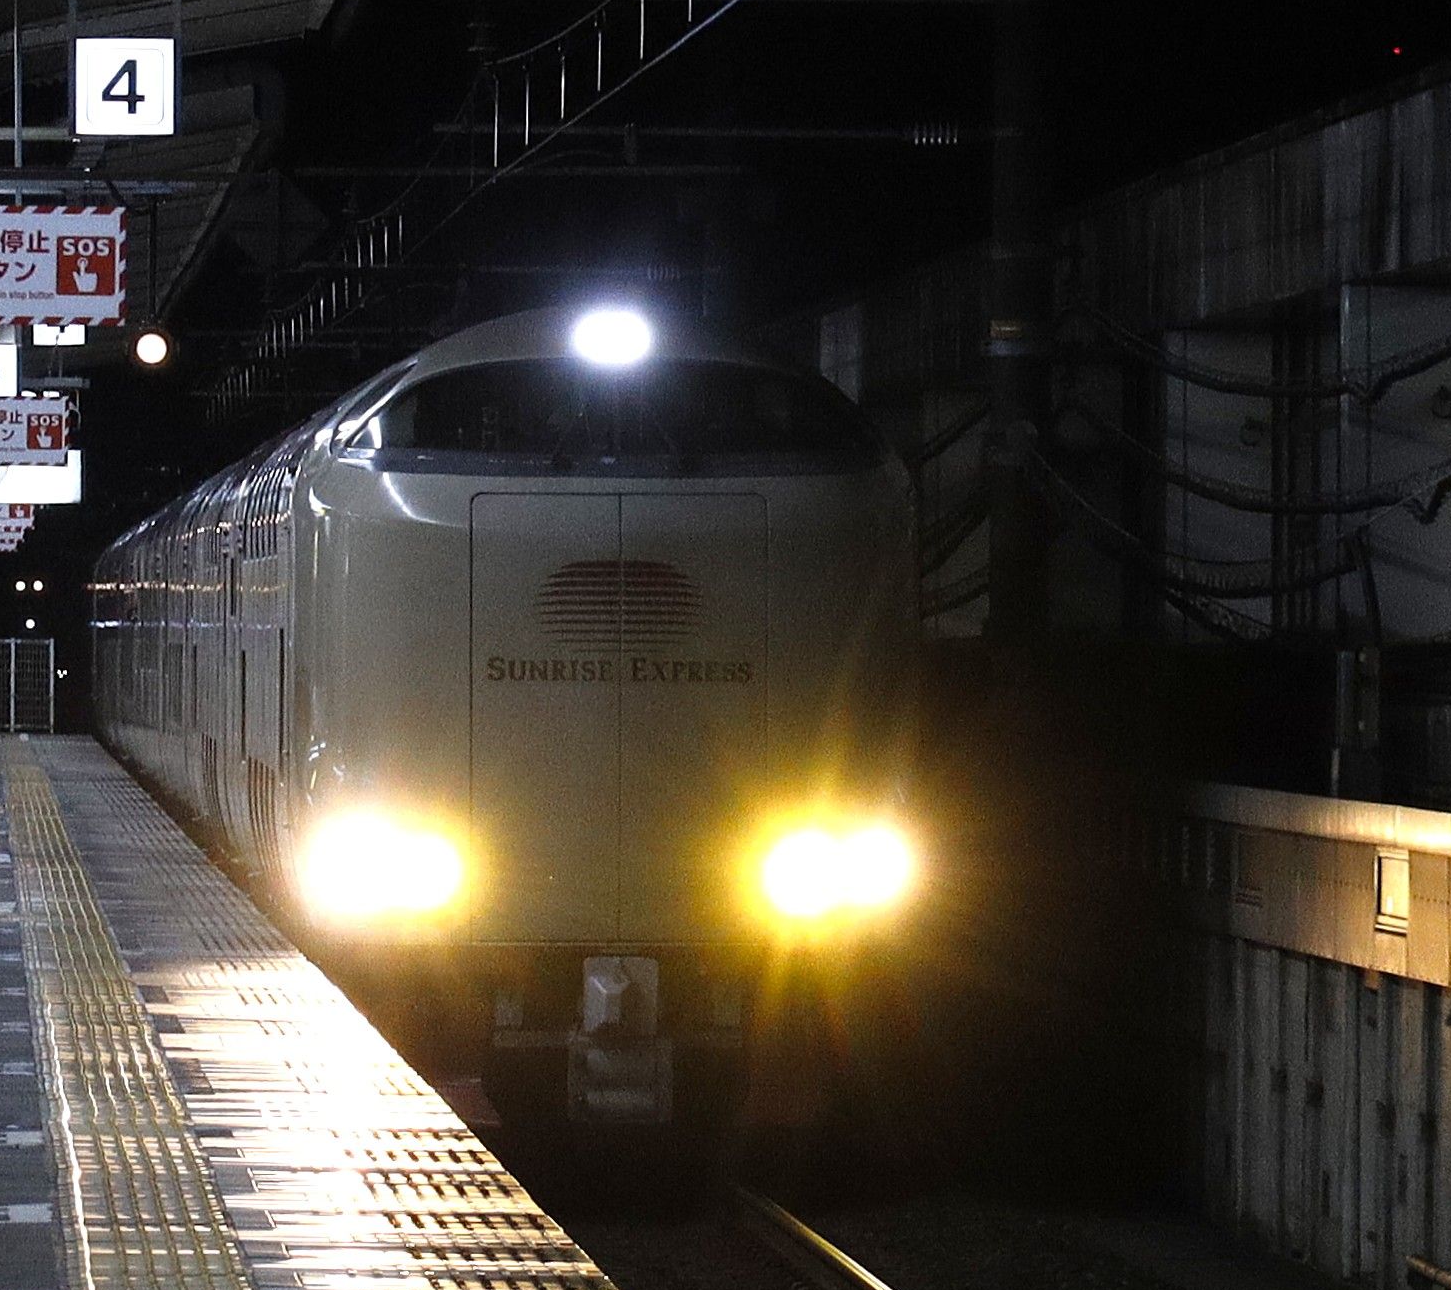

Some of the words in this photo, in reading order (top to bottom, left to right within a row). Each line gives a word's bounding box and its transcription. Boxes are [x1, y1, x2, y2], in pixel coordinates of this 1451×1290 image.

[102, 59, 145, 114] 4
[62, 238, 110, 256] SOS
[30, 414, 60, 427] SOS
[486, 656, 615, 683] SUNRISE
[630, 656, 752, 683] EXPRESS
